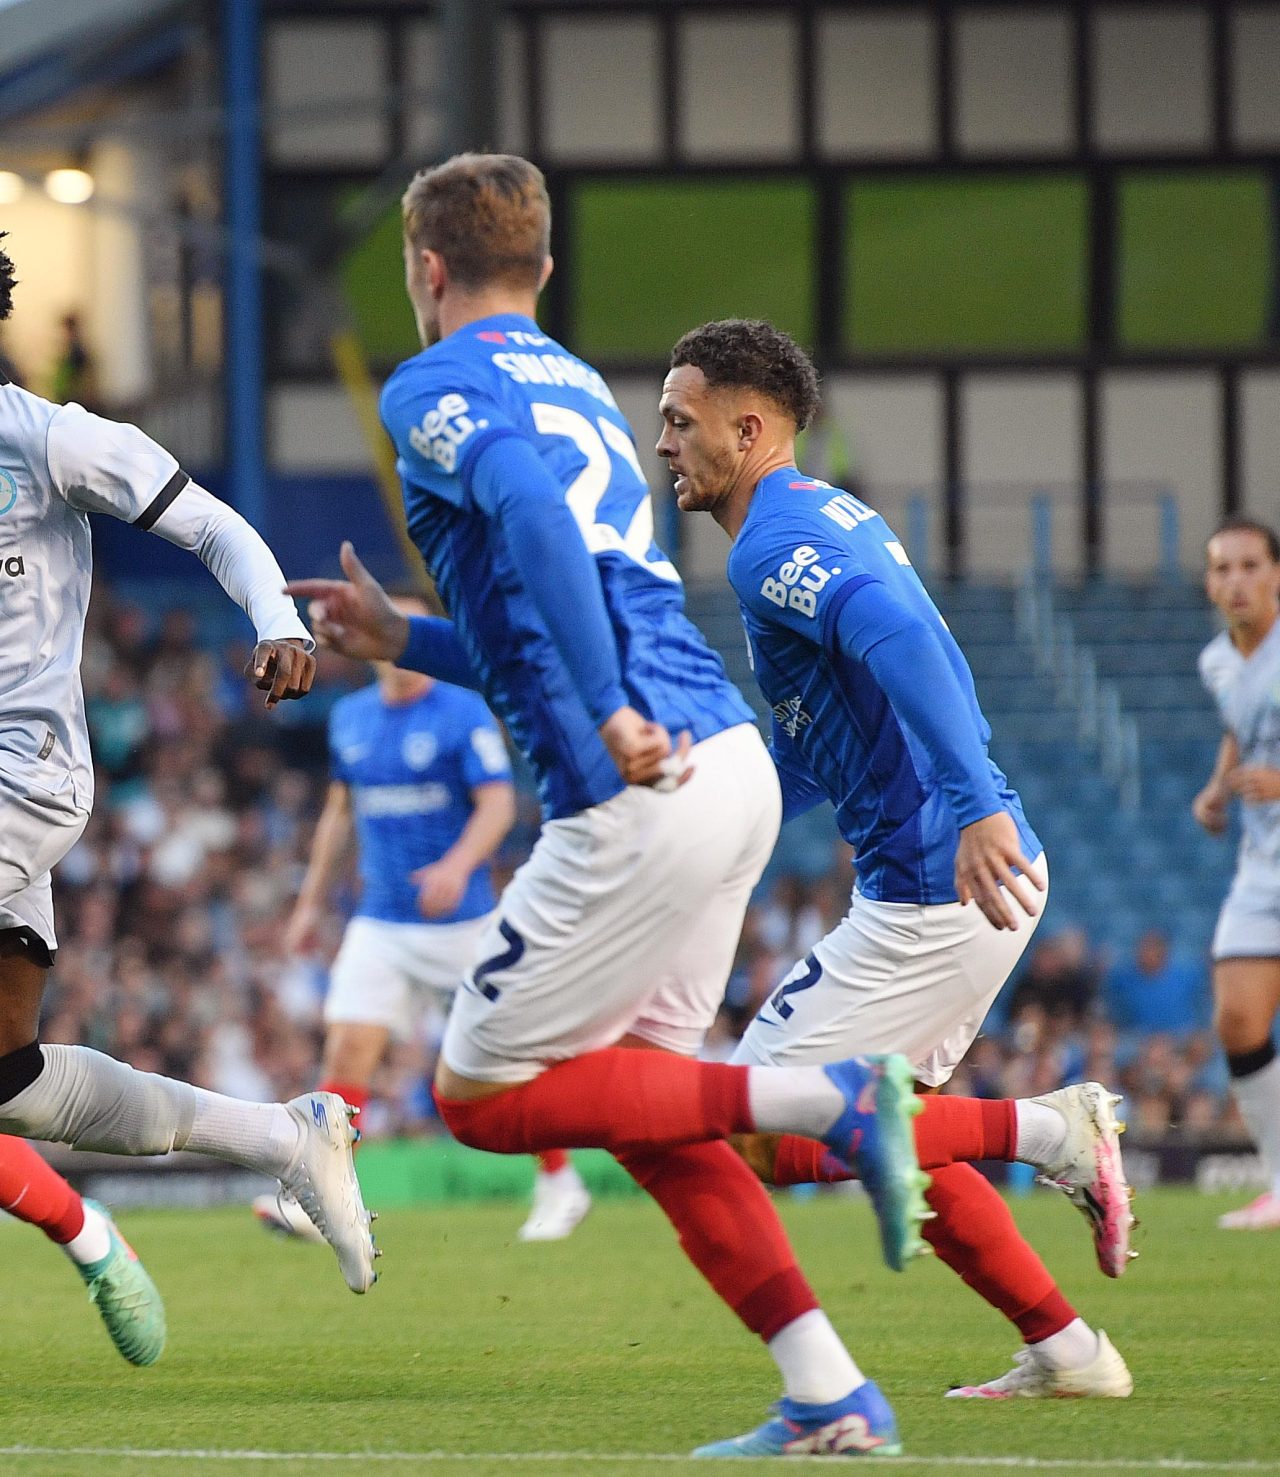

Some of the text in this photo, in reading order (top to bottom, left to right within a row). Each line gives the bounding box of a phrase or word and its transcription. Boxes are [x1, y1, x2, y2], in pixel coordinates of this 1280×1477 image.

[410, 393, 469, 460] Bee
[760, 545, 820, 608] Bee
[789, 564, 841, 618] Bu.
